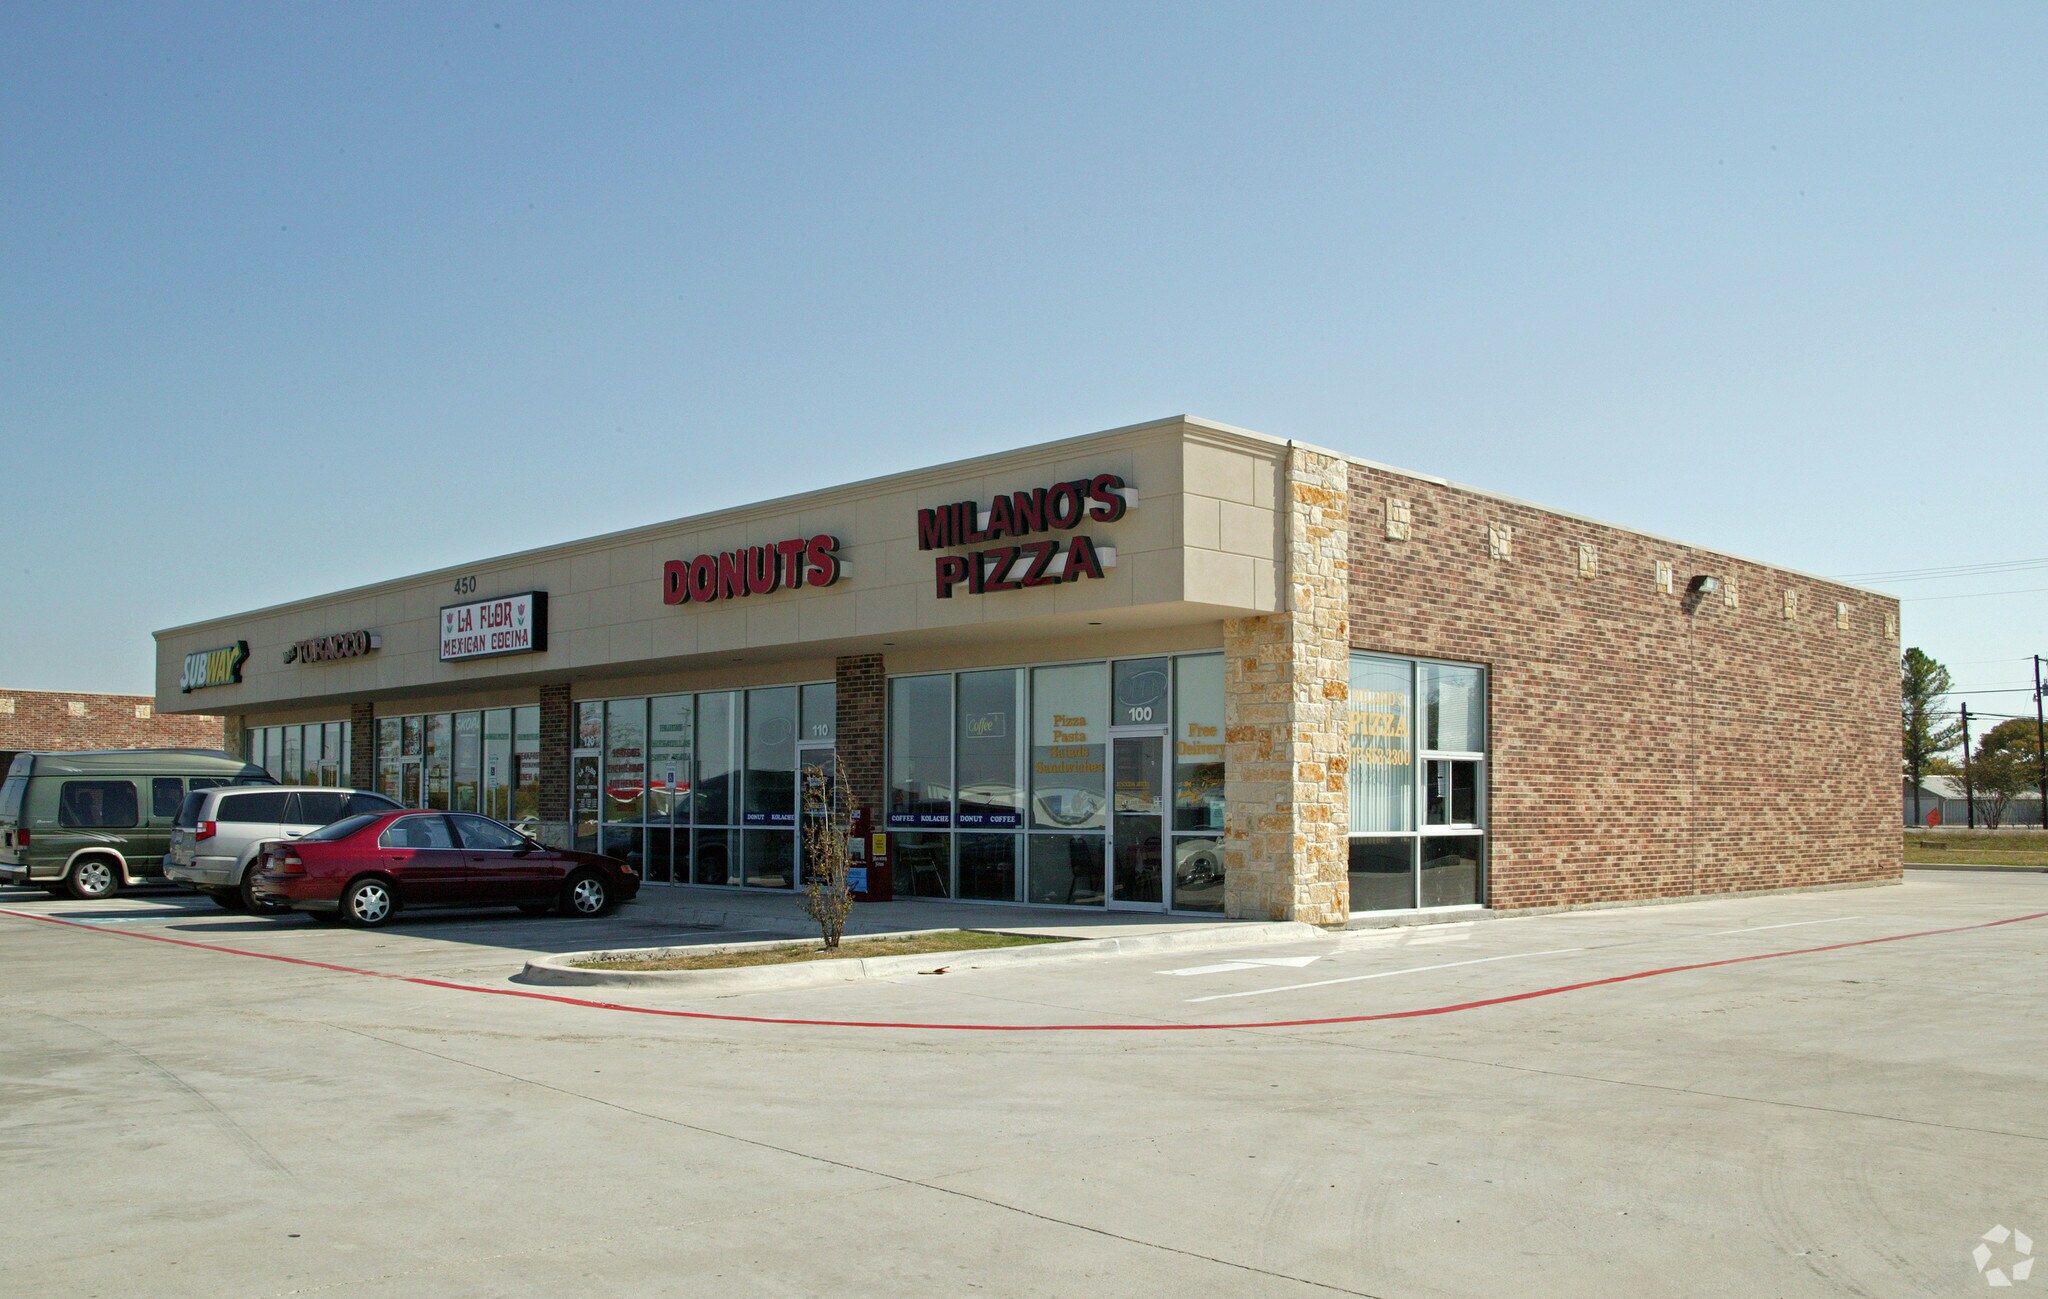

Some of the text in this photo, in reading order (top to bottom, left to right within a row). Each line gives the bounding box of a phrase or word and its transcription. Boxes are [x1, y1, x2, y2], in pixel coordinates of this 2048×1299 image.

[918, 473, 1124, 551] MILANO'S
[663, 534, 838, 605] DONUTS
[935, 536, 1102, 599] PIZZA
[454, 576, 476, 595] 450
[457, 601, 513, 632] LA FLOR
[295, 629, 368, 663] TOBACCO
[443, 629, 529, 656] MEXICAN COCINA
[180, 642, 243, 688] SUBWAY
[1053, 714, 1087, 727] Pizza
[1128, 706, 1153, 722] 100
[812, 723, 829, 737] 110
[968, 717, 993, 735] Coffee
[1188, 723, 1217, 738] Free
[1348, 711, 1409, 738] PIZZA
[583, 736, 596, 747] 120
[1053, 730, 1087, 743] Pasta
[1049, 745, 1090, 759] Salads
[1177, 740, 1226, 760] Delivery
[1036, 759, 1105, 774] Sandwiches
[747, 813, 765, 821] DONUT
[891, 814, 950, 823] COFFEE KOLACHE
[959, 815, 1016, 823] DONUT COFFEE
